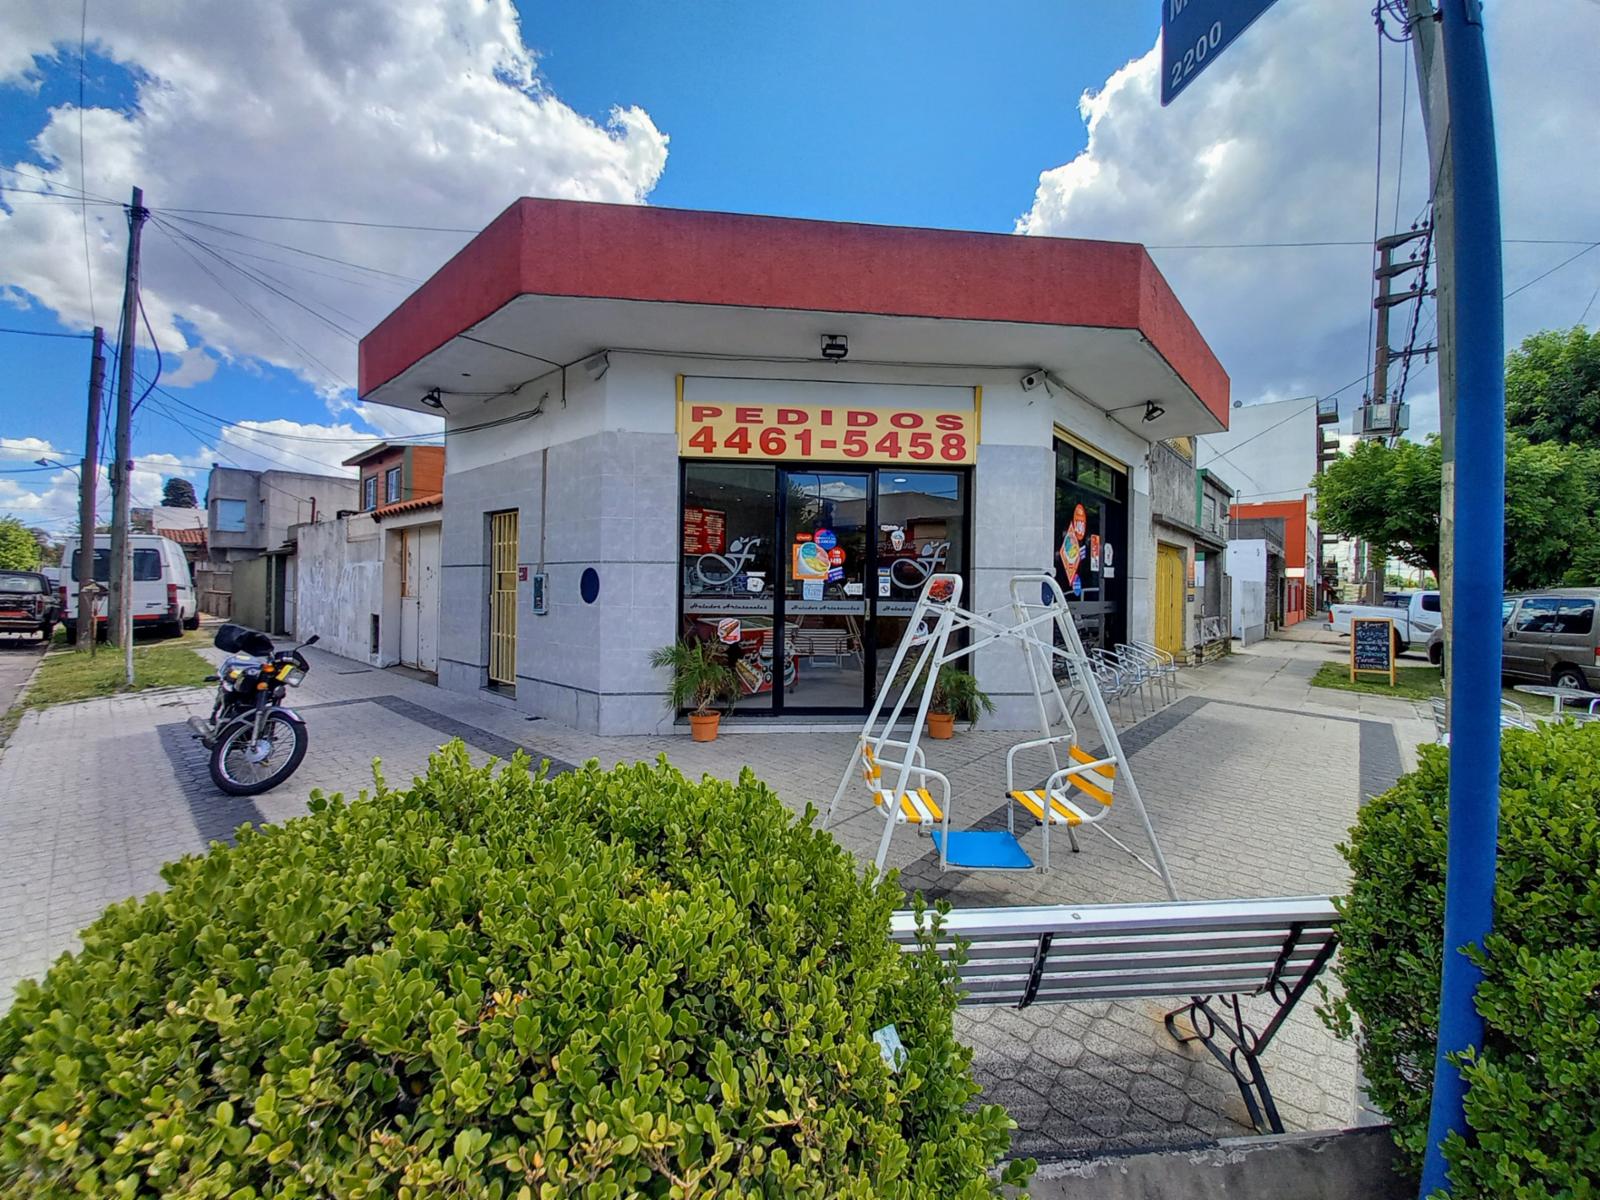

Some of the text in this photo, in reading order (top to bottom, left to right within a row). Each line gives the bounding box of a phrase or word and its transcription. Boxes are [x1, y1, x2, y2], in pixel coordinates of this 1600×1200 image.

[1171, 21, 1222, 89] 2200
[691, 405, 965, 431] PEDIDOS
[688, 425, 967, 461] 4461-5458
